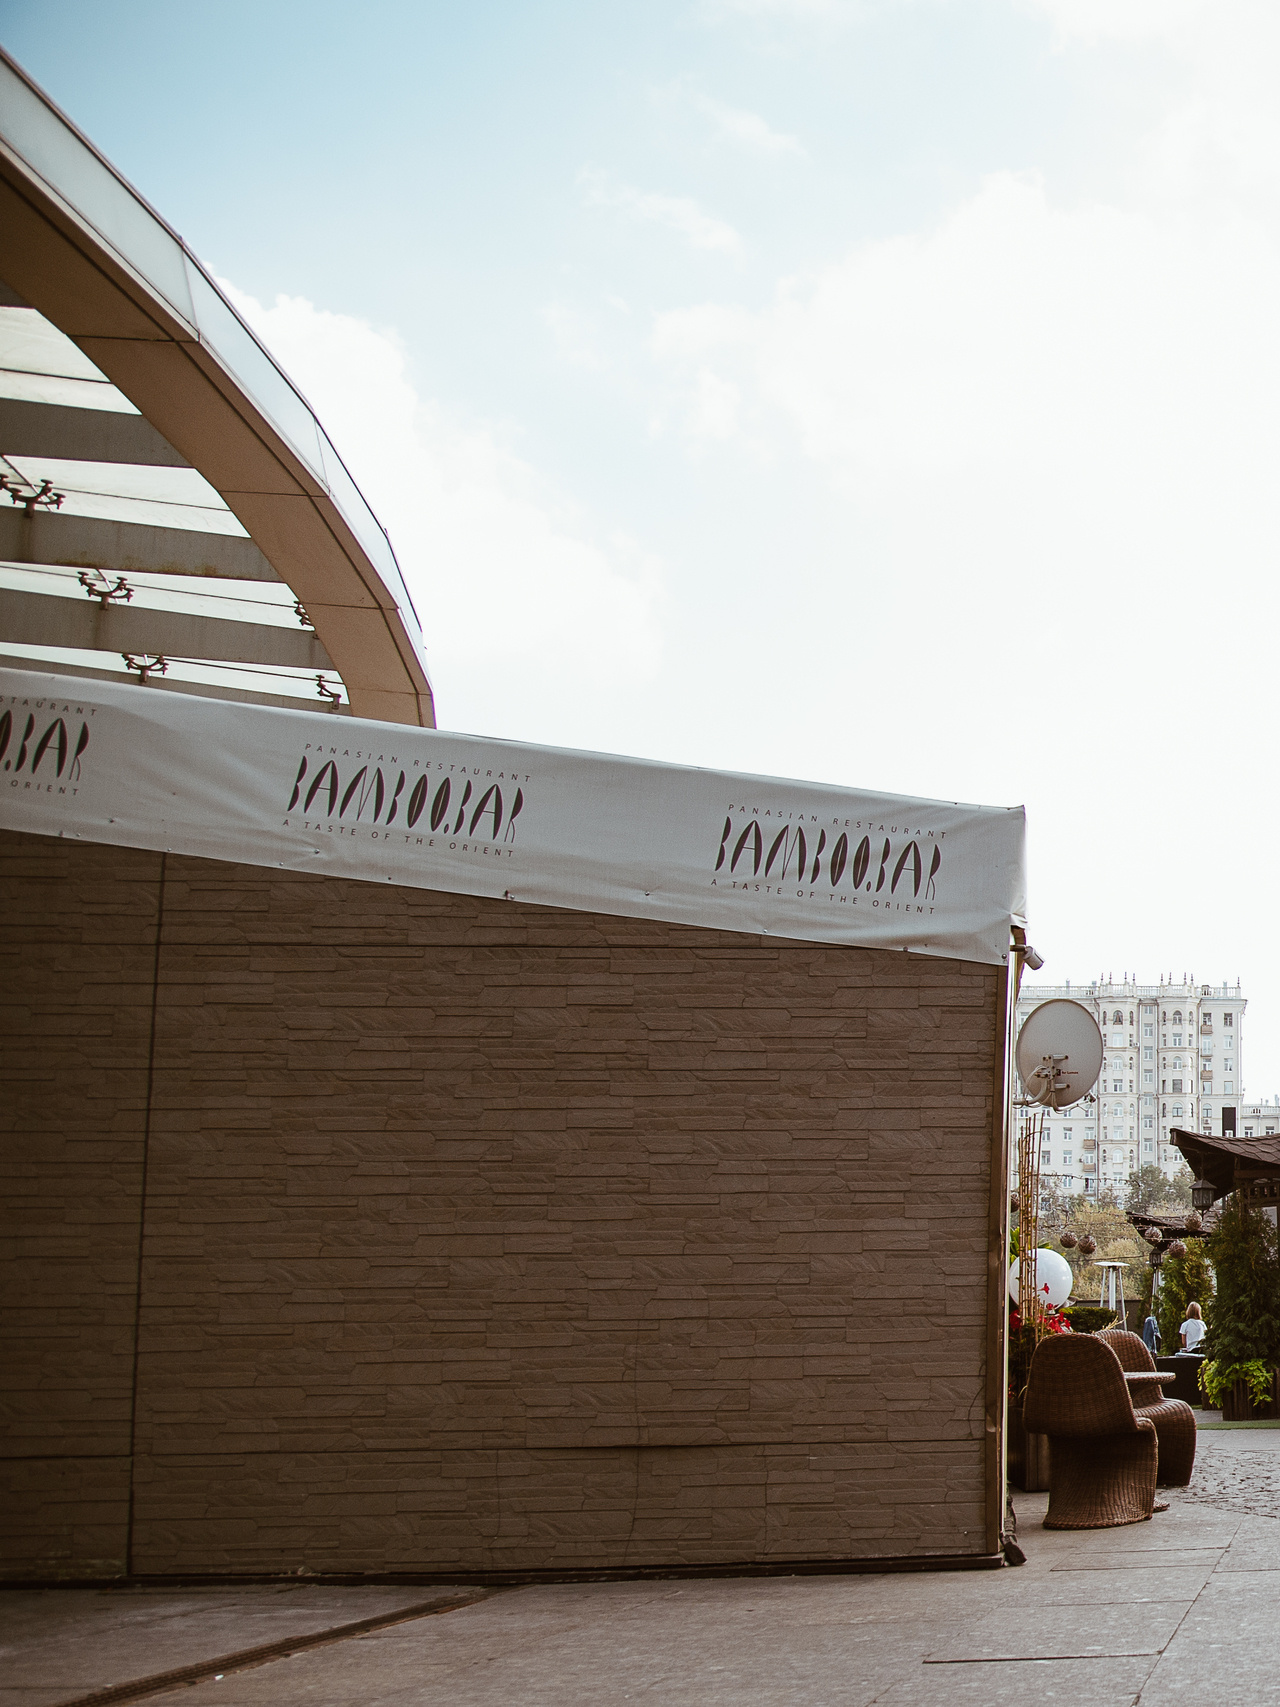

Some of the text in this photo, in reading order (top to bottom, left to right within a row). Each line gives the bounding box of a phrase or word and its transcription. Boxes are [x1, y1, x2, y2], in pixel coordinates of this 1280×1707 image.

[305, 743, 531, 782] PANASIAN RESTAURANT
[11, 779, 79, 796] ORIENT
[304, 821, 357, 836] TASTE
[371, 831, 390, 840] OF
[405, 835, 435, 847] THE
[449, 842, 514, 858] ORIENT
[728, 803, 947, 839] PANASIAN RESTAURANT
[710, 878, 935, 915] A TASTE OF THE ORIENT
